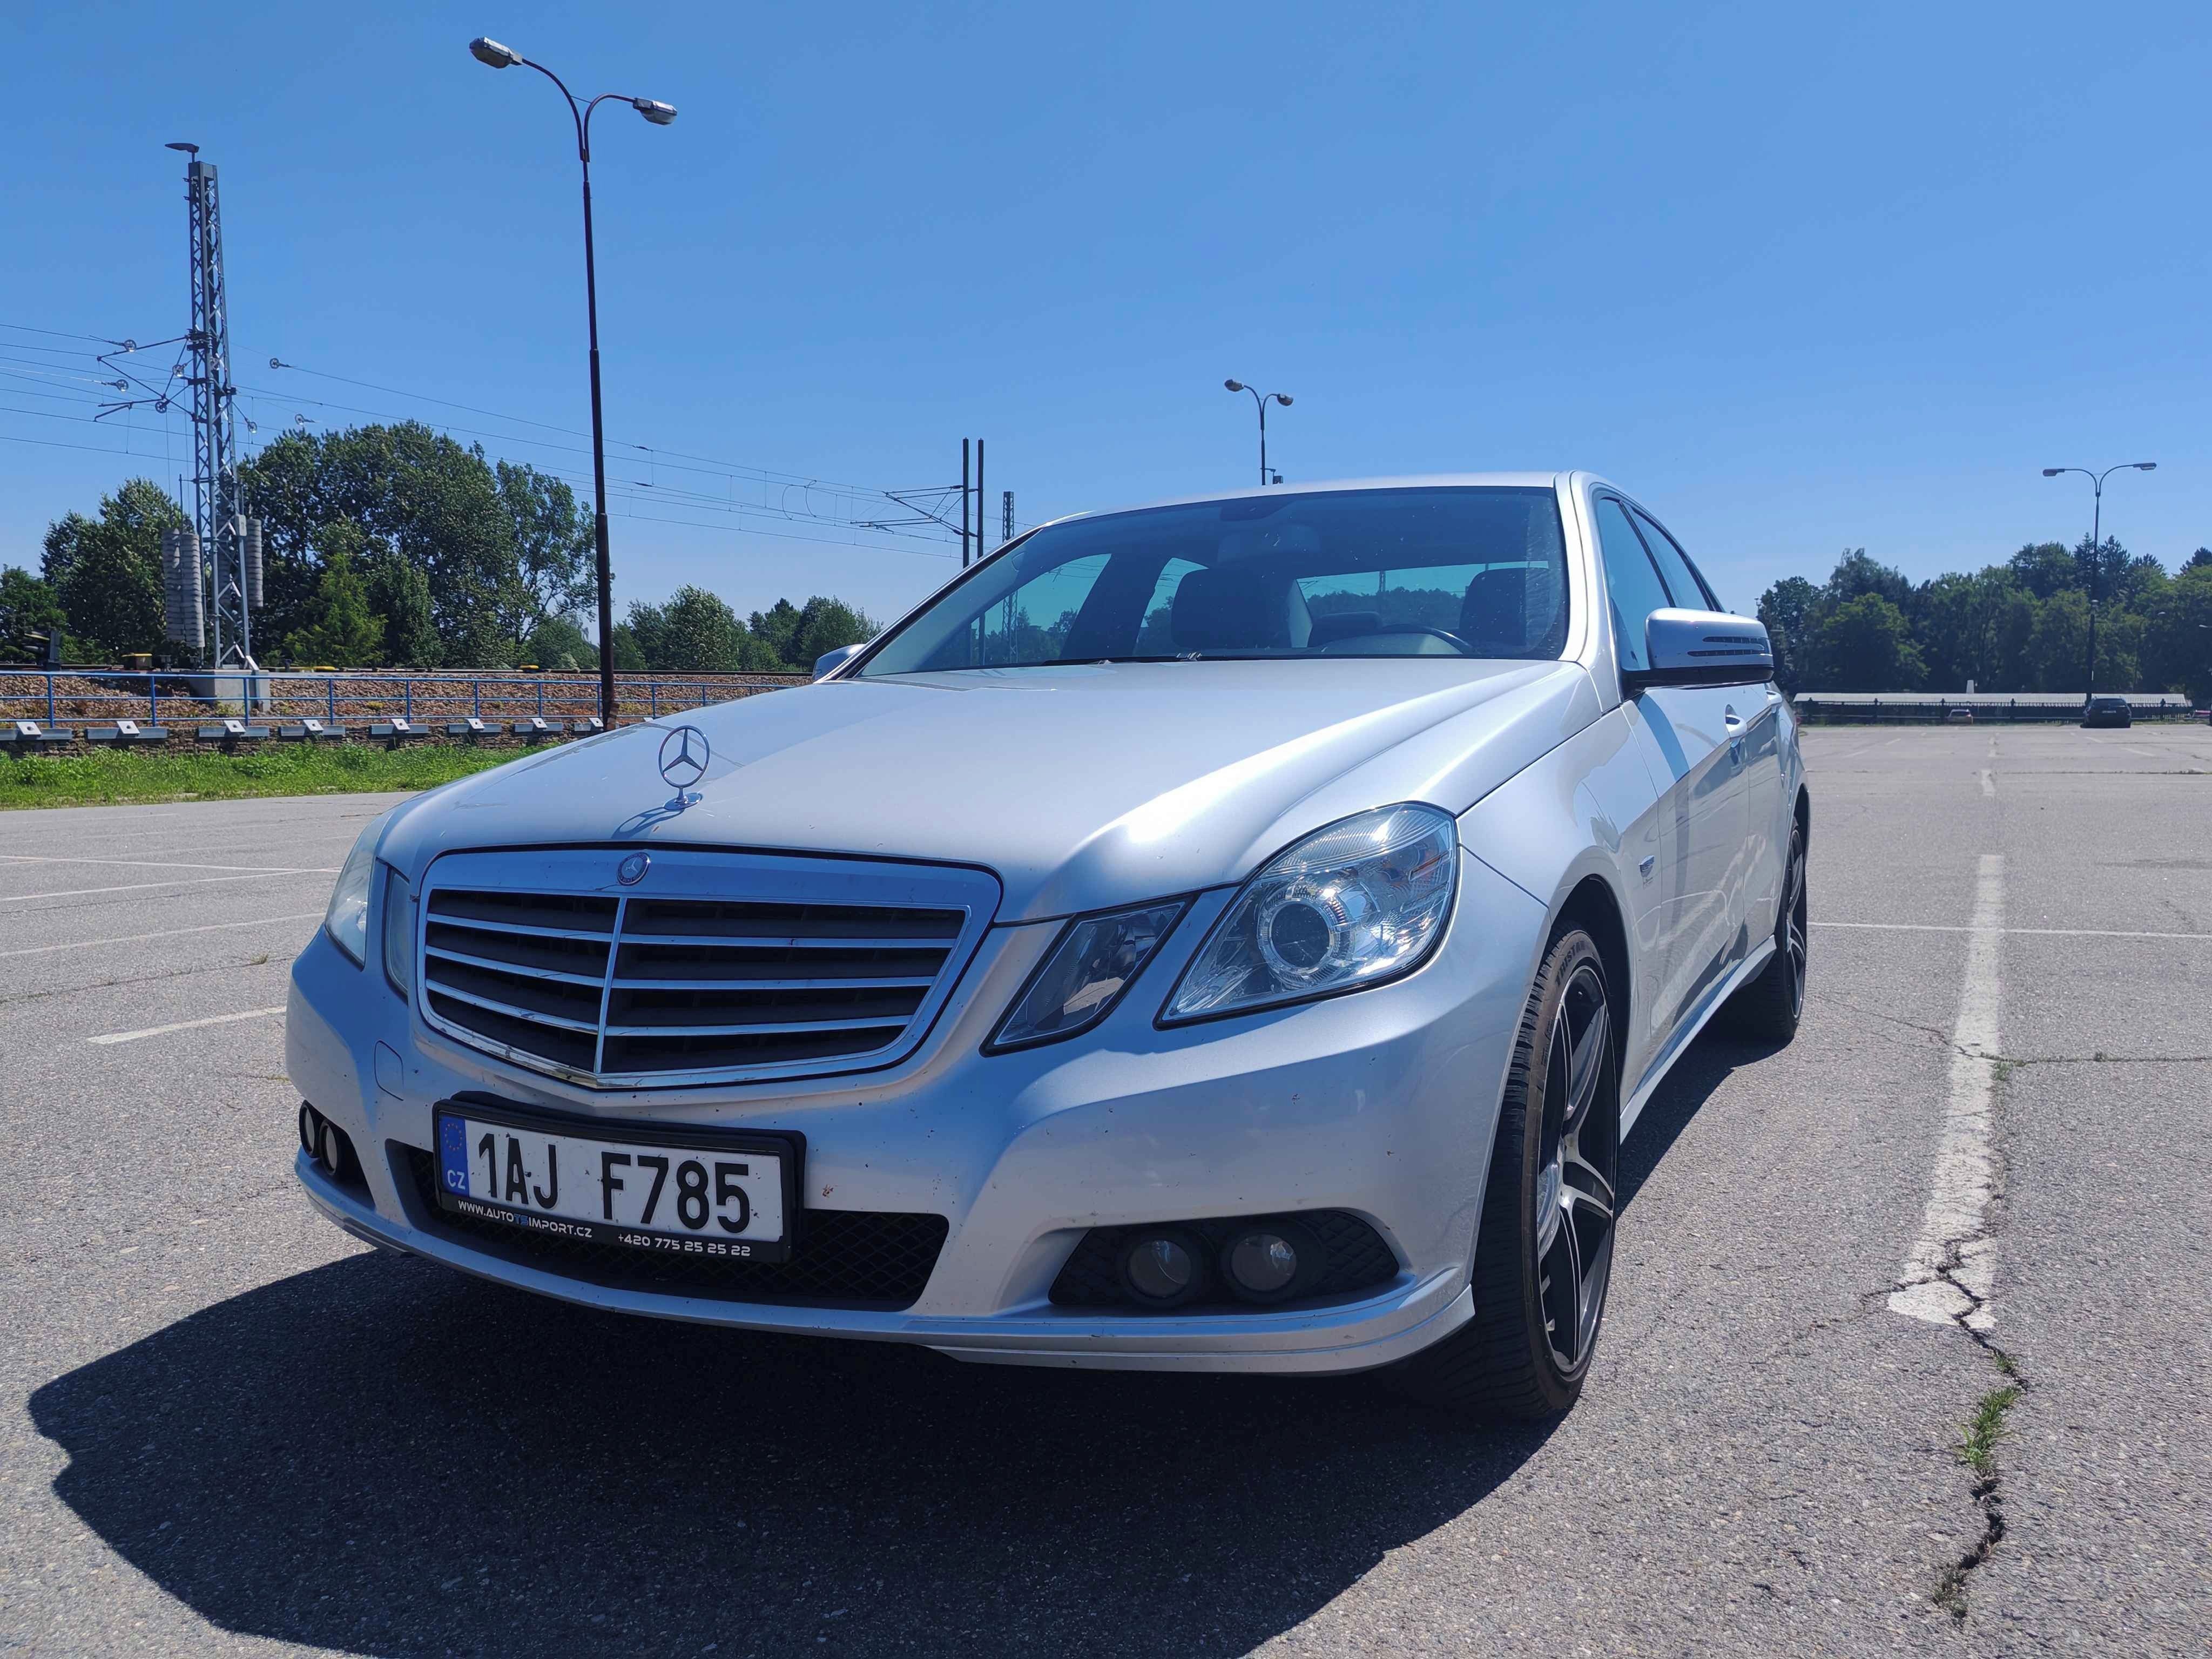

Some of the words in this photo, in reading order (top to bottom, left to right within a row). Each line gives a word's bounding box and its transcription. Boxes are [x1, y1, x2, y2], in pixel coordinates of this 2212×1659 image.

[447, 1169, 466, 1190] CZ
[478, 1132, 557, 1209] 1AJ
[601, 1151, 751, 1234] F785
[458, 1199, 593, 1238] WWW.AUTOTSIMPORT.CZ
[618, 1233, 651, 1247] +420
[654, 1237, 680, 1250] 775
[684, 1241, 703, 1252] 25
[707, 1243, 727, 1255] 25
[731, 1245, 751, 1257] 22
